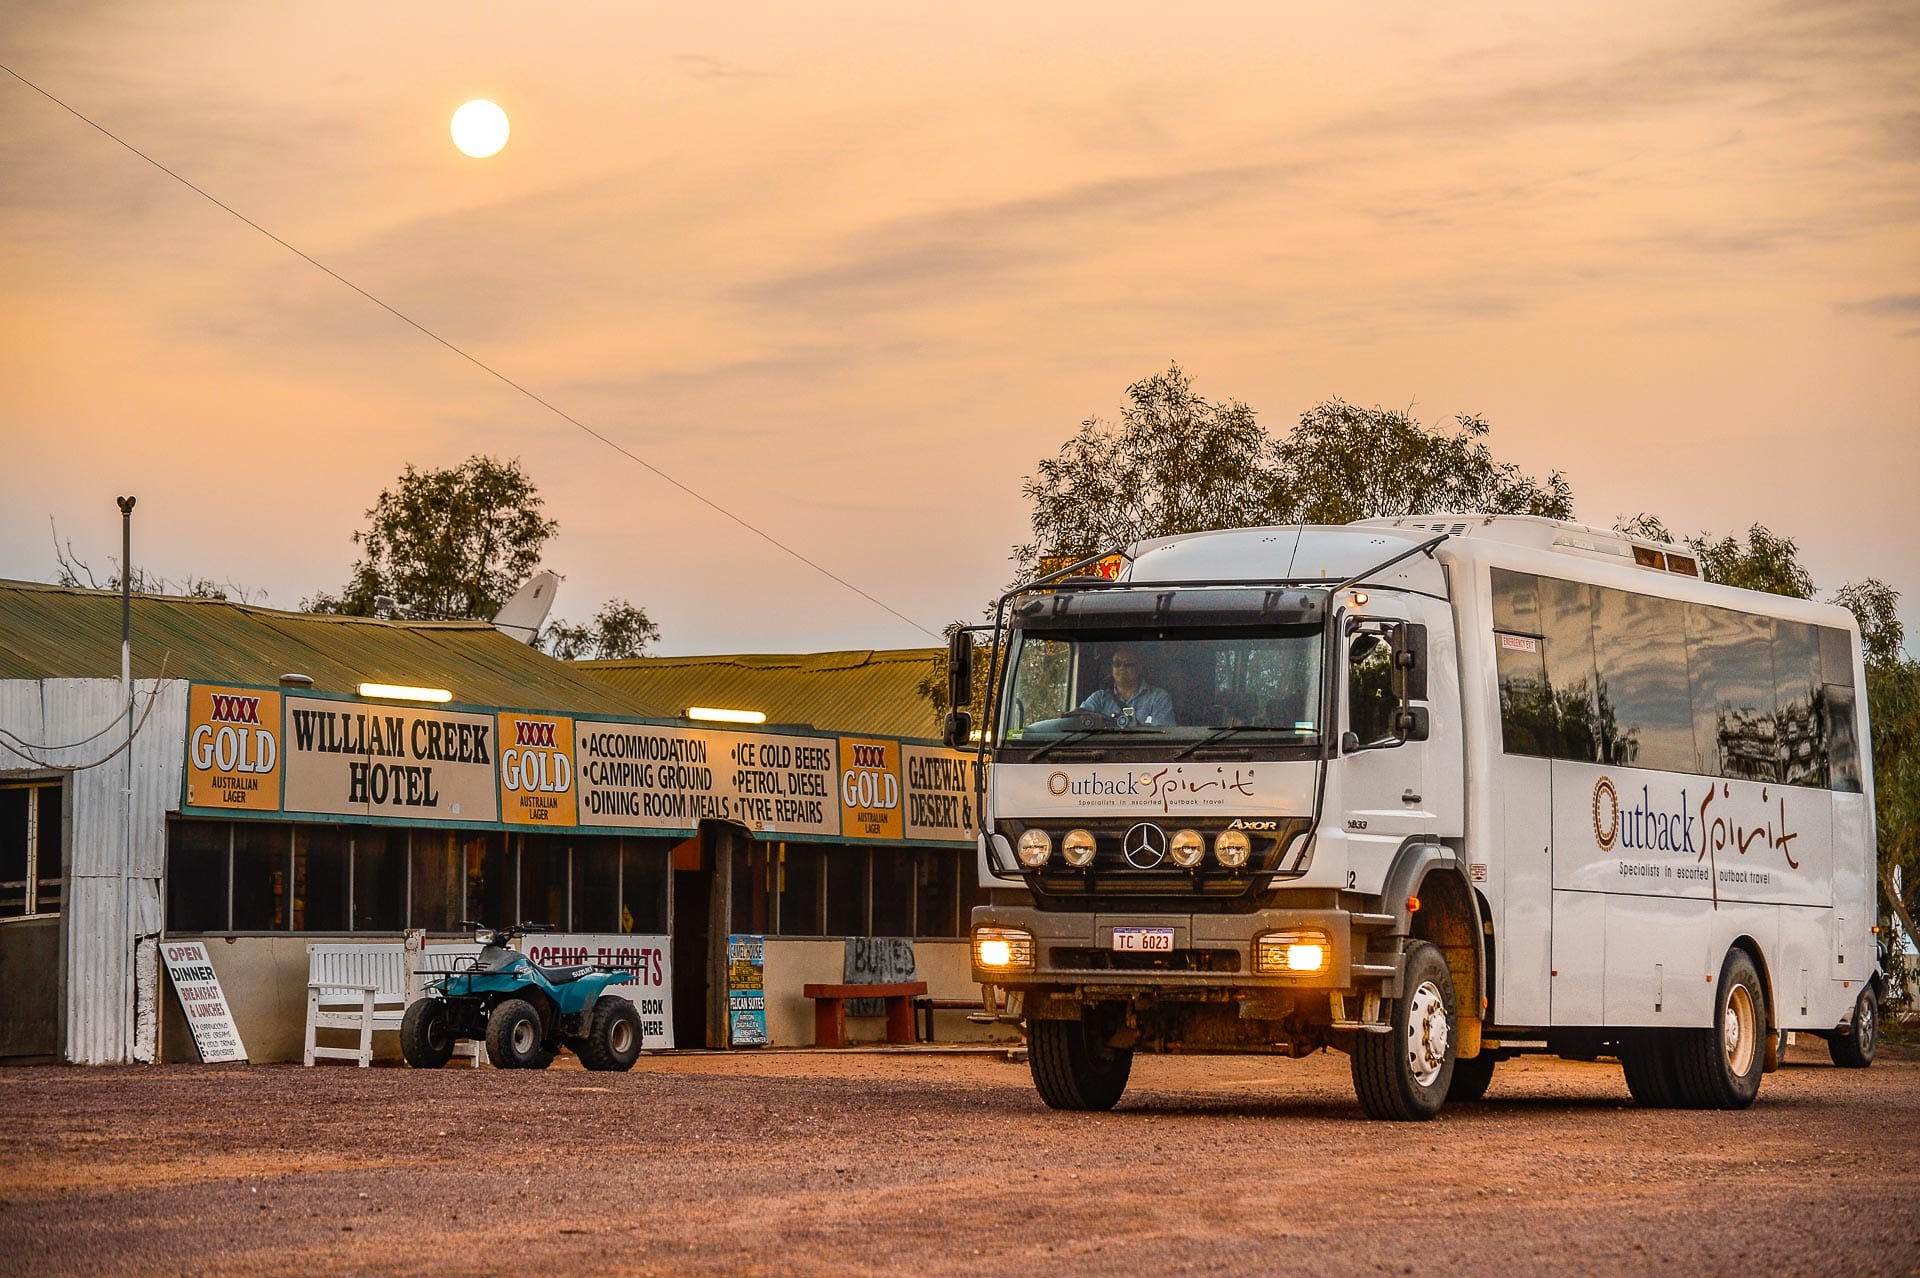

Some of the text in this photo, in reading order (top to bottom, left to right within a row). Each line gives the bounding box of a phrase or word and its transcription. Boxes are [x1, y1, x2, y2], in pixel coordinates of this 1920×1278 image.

[210, 693, 261, 725] XXXX
[292, 709, 490, 765] WILLIAM CREEK
[514, 720, 557, 748] XXXX
[191, 724, 277, 773] GOLD
[589, 733, 706, 763] ACCOMMODATION
[737, 743, 830, 771] ICE COLD BEERS
[852, 744, 887, 769] XXXX
[212, 775, 258, 791] AUSTRALIAN
[501, 748, 571, 793] GOLD
[590, 761, 712, 790] CAMPING GROUND
[909, 756, 966, 792] GATEWAY
[349, 762, 439, 807] HOTEL
[738, 770, 828, 797] PETROL, DIESEL
[842, 770, 899, 809] GOLD
[1047, 767, 1255, 813] Outback Spirit
[223, 790, 246, 803] LAGER
[520, 796, 558, 809] AUSTRALIAN
[591, 790, 729, 819] DINING ROOM MEALS
[529, 807, 549, 821] LAGER
[739, 798, 823, 824] TYRE REPAIRS
[857, 811, 888, 824] AUSTRALIAN
[909, 793, 972, 829] DESERT &
[864, 822, 881, 834] LAGER
[1592, 775, 1799, 911] Outback Spirit
[1619, 861, 1770, 885] Specialists in escorted outback travel
[168, 946, 203, 962] OPEN
[1119, 935, 1169, 949] TC 6023
[170, 966, 215, 981] DINNER
[572, 966, 593, 978] SUZUKI
[181, 986, 220, 1001] BREAKFAST
[730, 997, 748, 1010] PELICAN
[196, 1002, 225, 1017] LUNCHES
[642, 1000, 663, 1014] BOOK
[643, 1021, 663, 1035] HERE
